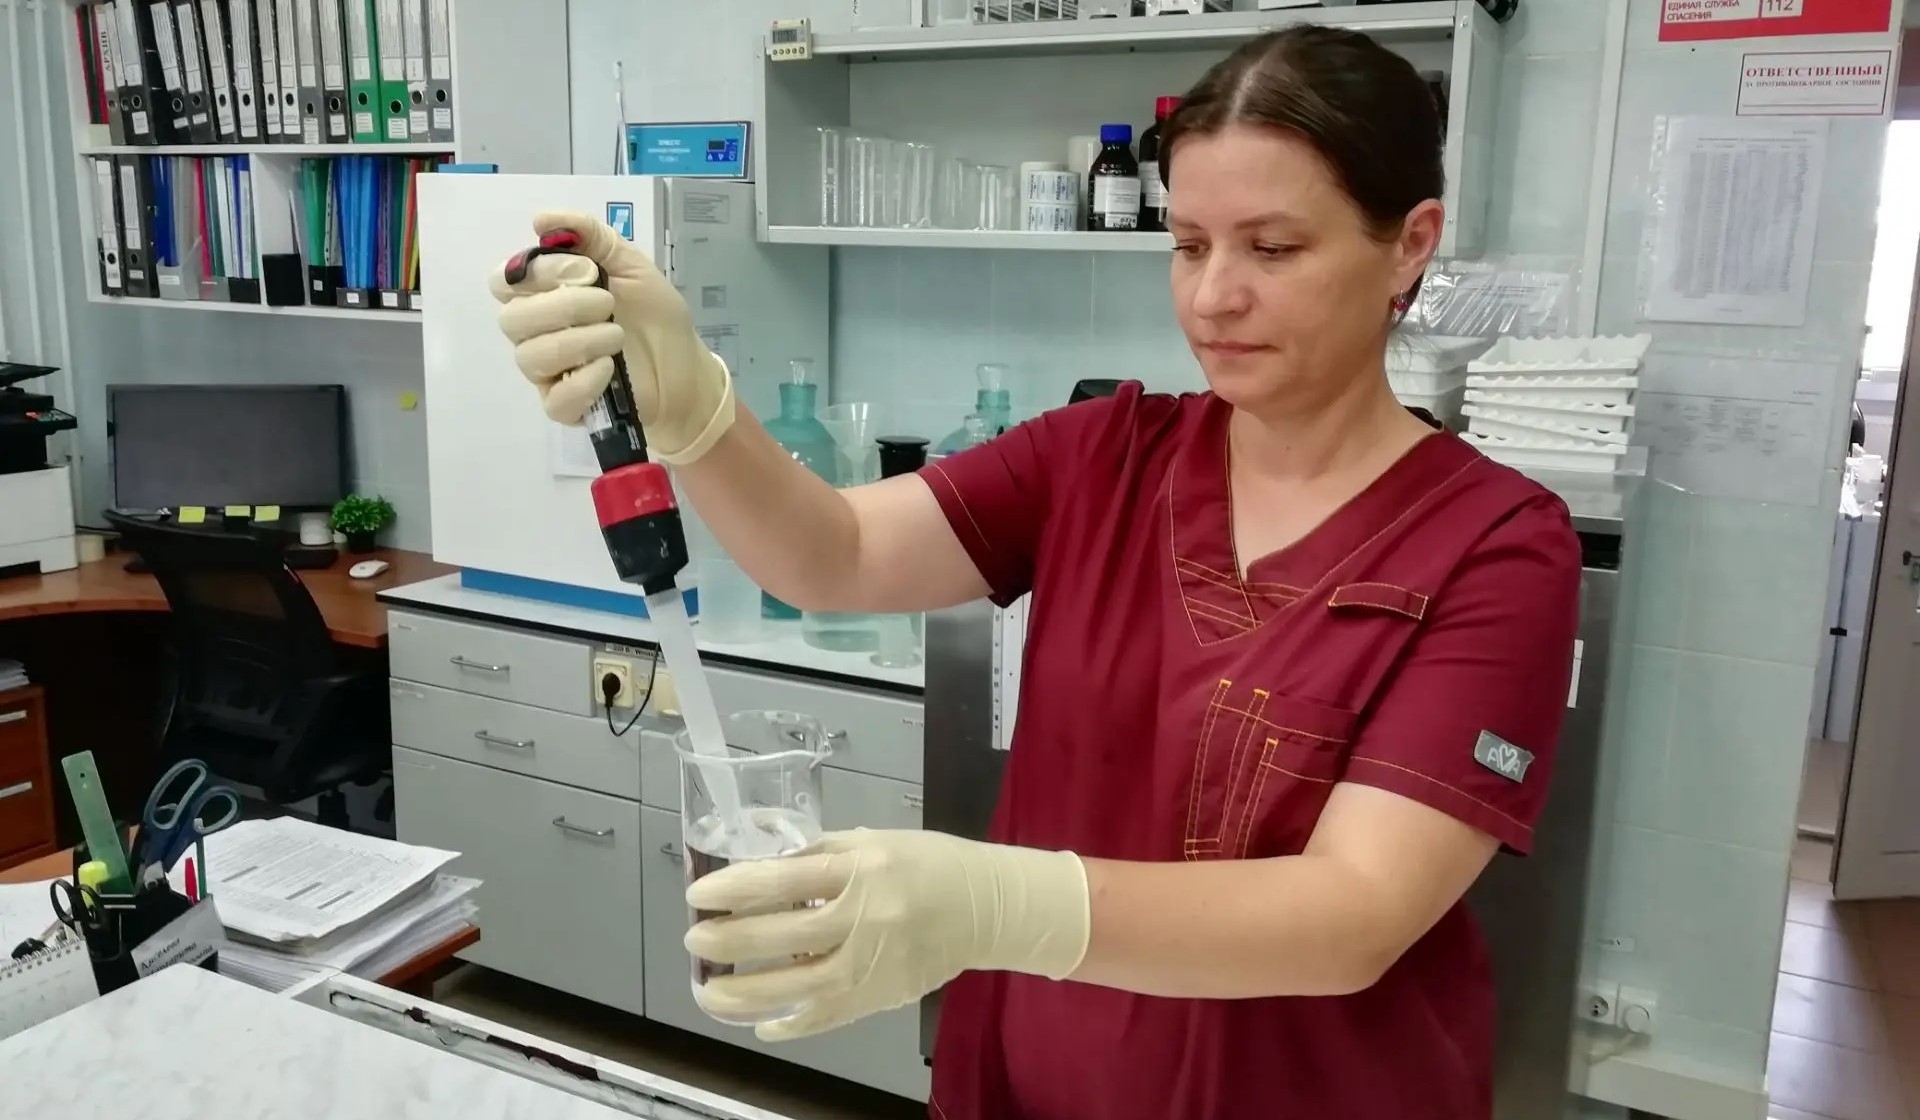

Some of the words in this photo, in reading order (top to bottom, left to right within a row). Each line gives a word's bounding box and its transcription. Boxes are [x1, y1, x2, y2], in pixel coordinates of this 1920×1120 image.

[1667, 1, 1702, 11] ЕДИНАЯ
[1704, 0, 1740, 9] СЛУЖБА
[1766, 0, 1794, 12] 112
[1666, 11, 1712, 21] СПАСЕНИЯ
[1745, 64, 1883, 77] ОТВЕТСТВЕННЫЙ
